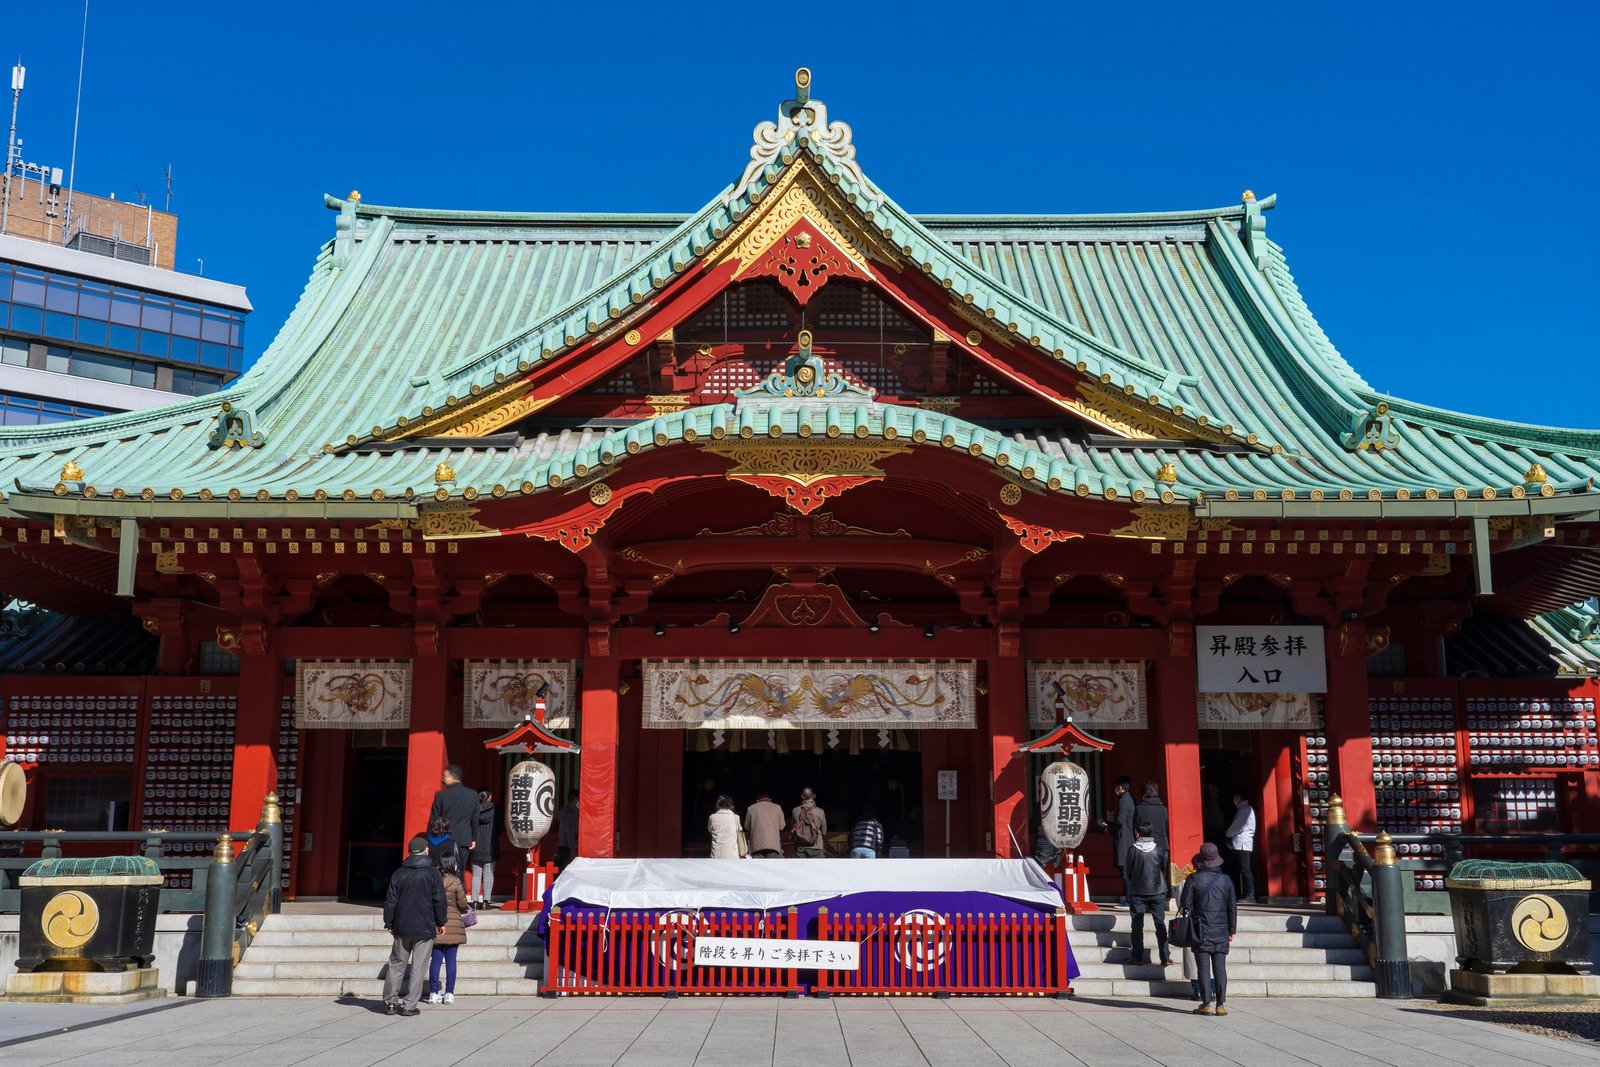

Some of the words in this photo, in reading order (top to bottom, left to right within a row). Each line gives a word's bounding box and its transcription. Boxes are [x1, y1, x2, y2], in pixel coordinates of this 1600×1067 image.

[1209, 634, 1308, 657] 昇殿参拝
[1236, 666, 1282, 684] 入口
[510, 773, 535, 834] 神田明神
[1056, 775, 1082, 838] 神田明神
[699, 945, 852, 963] 階段を昇りご参拝下さい
